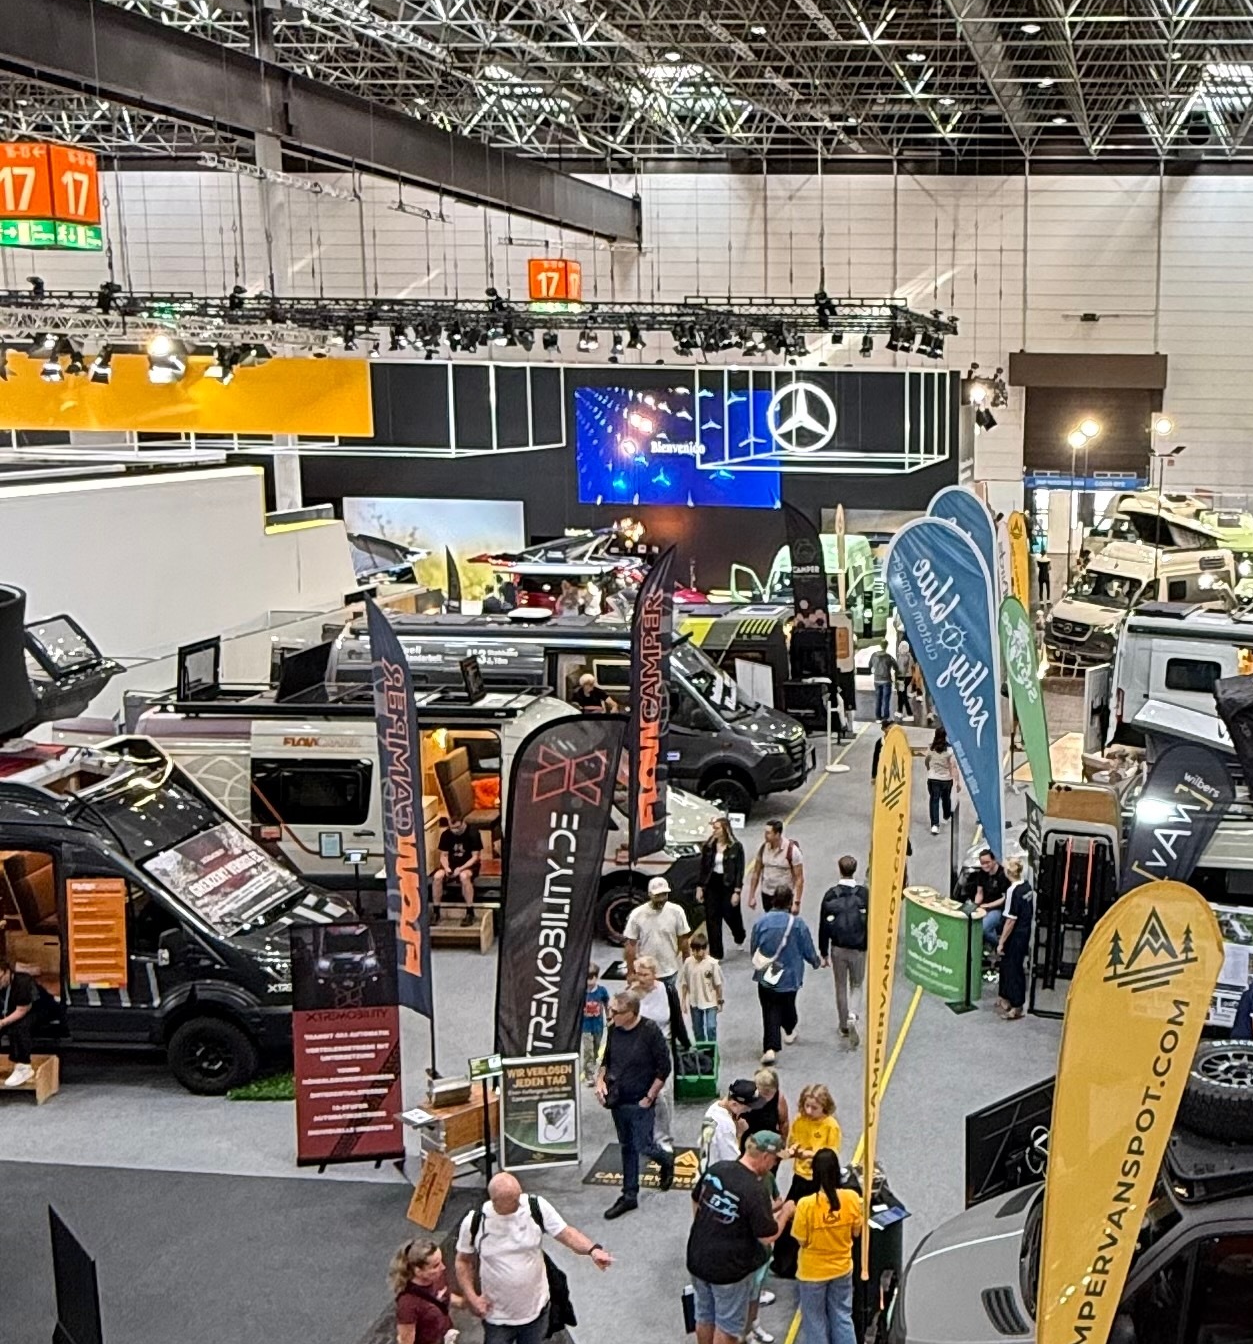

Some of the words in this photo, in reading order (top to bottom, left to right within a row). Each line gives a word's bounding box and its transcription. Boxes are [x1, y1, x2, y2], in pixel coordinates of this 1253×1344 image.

[0, 166, 36, 211] 17
[61, 170, 90, 216] 17
[537, 271, 560, 298] 17
[1183, 771, 1221, 798] wilbers
[526, 811, 580, 1057] TREMOBILITY.DE
[868, 812, 905, 1128] CAMPERVANSPOT.COM
[507, 1067, 525, 1078] WIR
[526, 1064, 573, 1077] VERLOSEN
[513, 1078, 544, 1089] JEDEN
[546, 1075, 567, 1086] TAG
